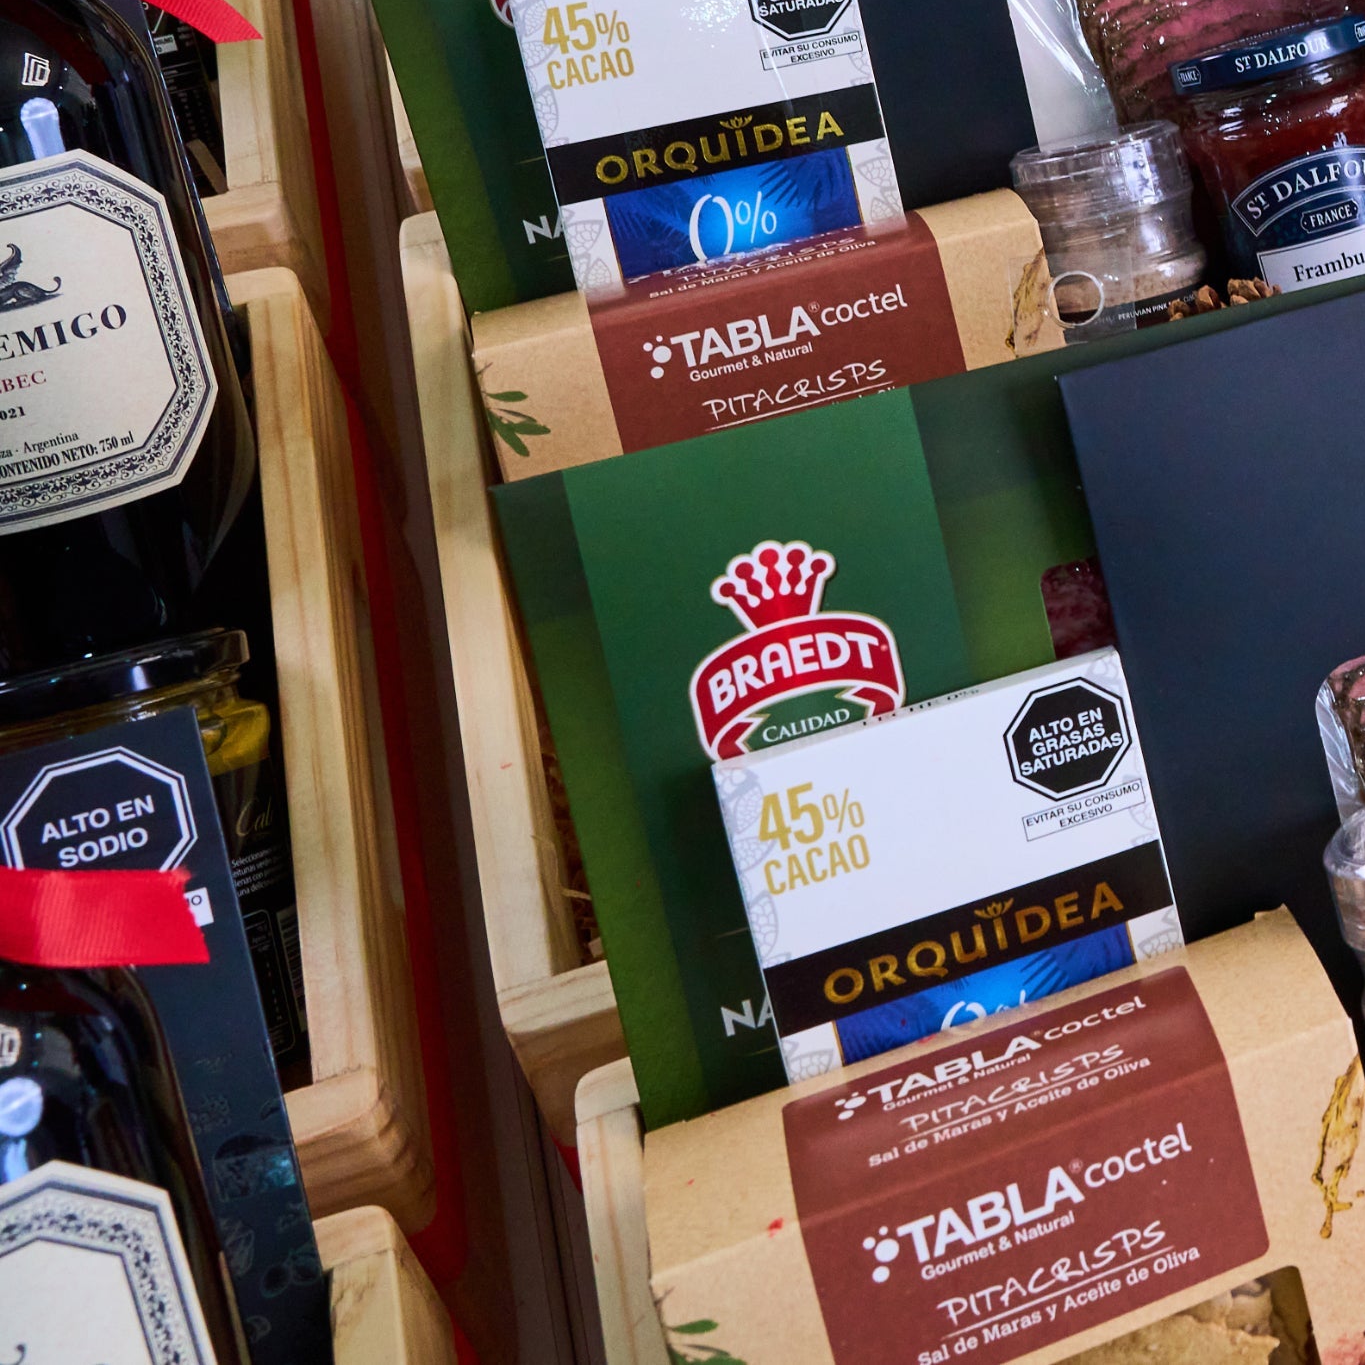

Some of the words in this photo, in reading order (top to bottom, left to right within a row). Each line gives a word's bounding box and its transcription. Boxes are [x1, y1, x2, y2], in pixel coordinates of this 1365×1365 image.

[543, 1, 632, 56] 45%
[1235, 55, 1251, 73] ST
[1253, 35, 1329, 69] DALFOUR
[547, 45, 636, 91] CACAO
[1245, 191, 1270, 220] ST
[1308, 203, 1354, 228] FRANCE
[671, 308, 821, 369] TABLA
[821, 284, 908, 326] coctel
[702, 358, 887, 423] PITACRISPS
[707, 631, 883, 713] BRAEDT
[761, 706, 851, 746] CALIDAD
[41, 807, 111, 844] ALTO
[115, 794, 156, 823] EN
[58, 826, 150, 870] SODIO
[763, 833, 872, 897] CACAO
[896, 1166, 1085, 1264] TABLA
[1085, 1122, 1192, 1188] coctel
[936, 1220, 1166, 1326] PITACRISPS
